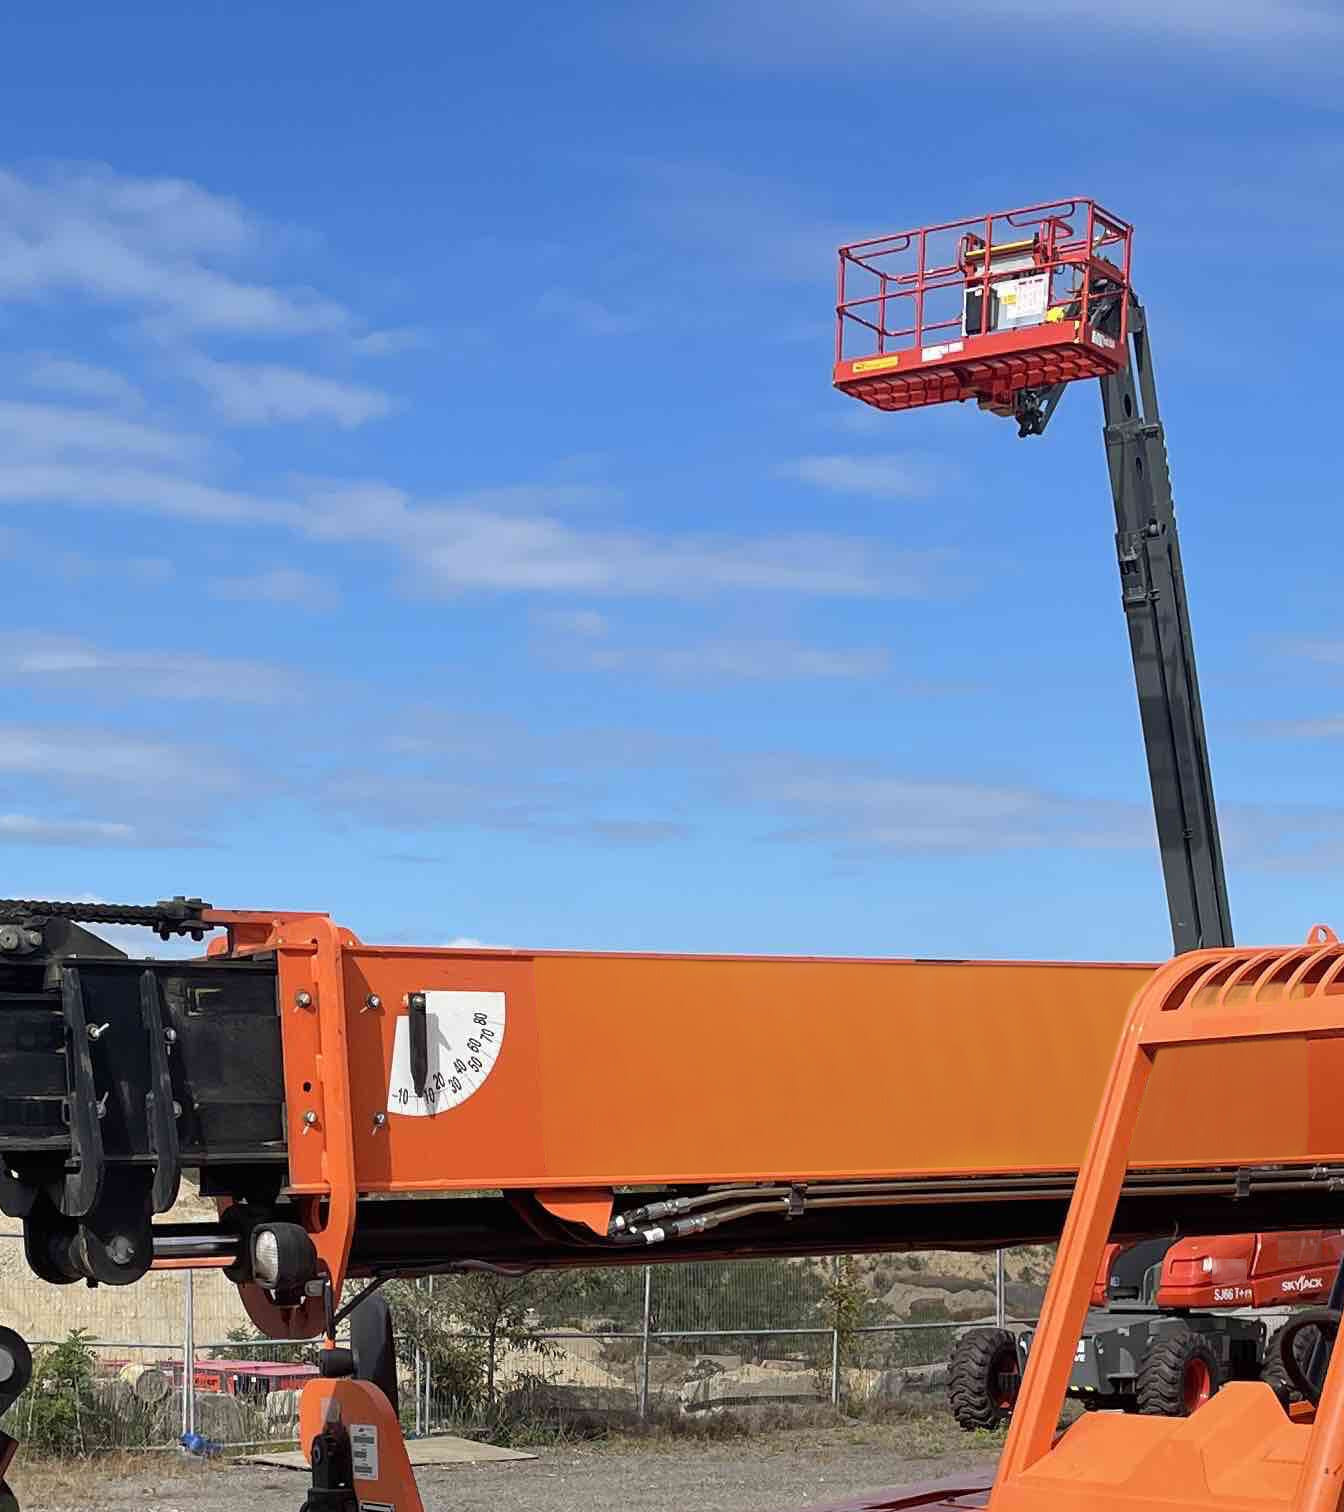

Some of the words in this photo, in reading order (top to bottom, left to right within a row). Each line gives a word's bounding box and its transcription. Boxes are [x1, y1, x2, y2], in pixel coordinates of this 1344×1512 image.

[473, 1012, 488, 1026] 80
[480, 1028, 495, 1043] 70
[466, 1037, 482, 1053] 60
[452, 1057, 468, 1075] 40
[467, 1056, 483, 1073] 50
[432, 1071, 446, 1090] 20
[447, 1076, 462, 1094] 30
[392, 1087, 409, 1105] -10
[424, 1087, 435, 1104] 10
[1281, 1275, 1323, 1291] SKYJACK
